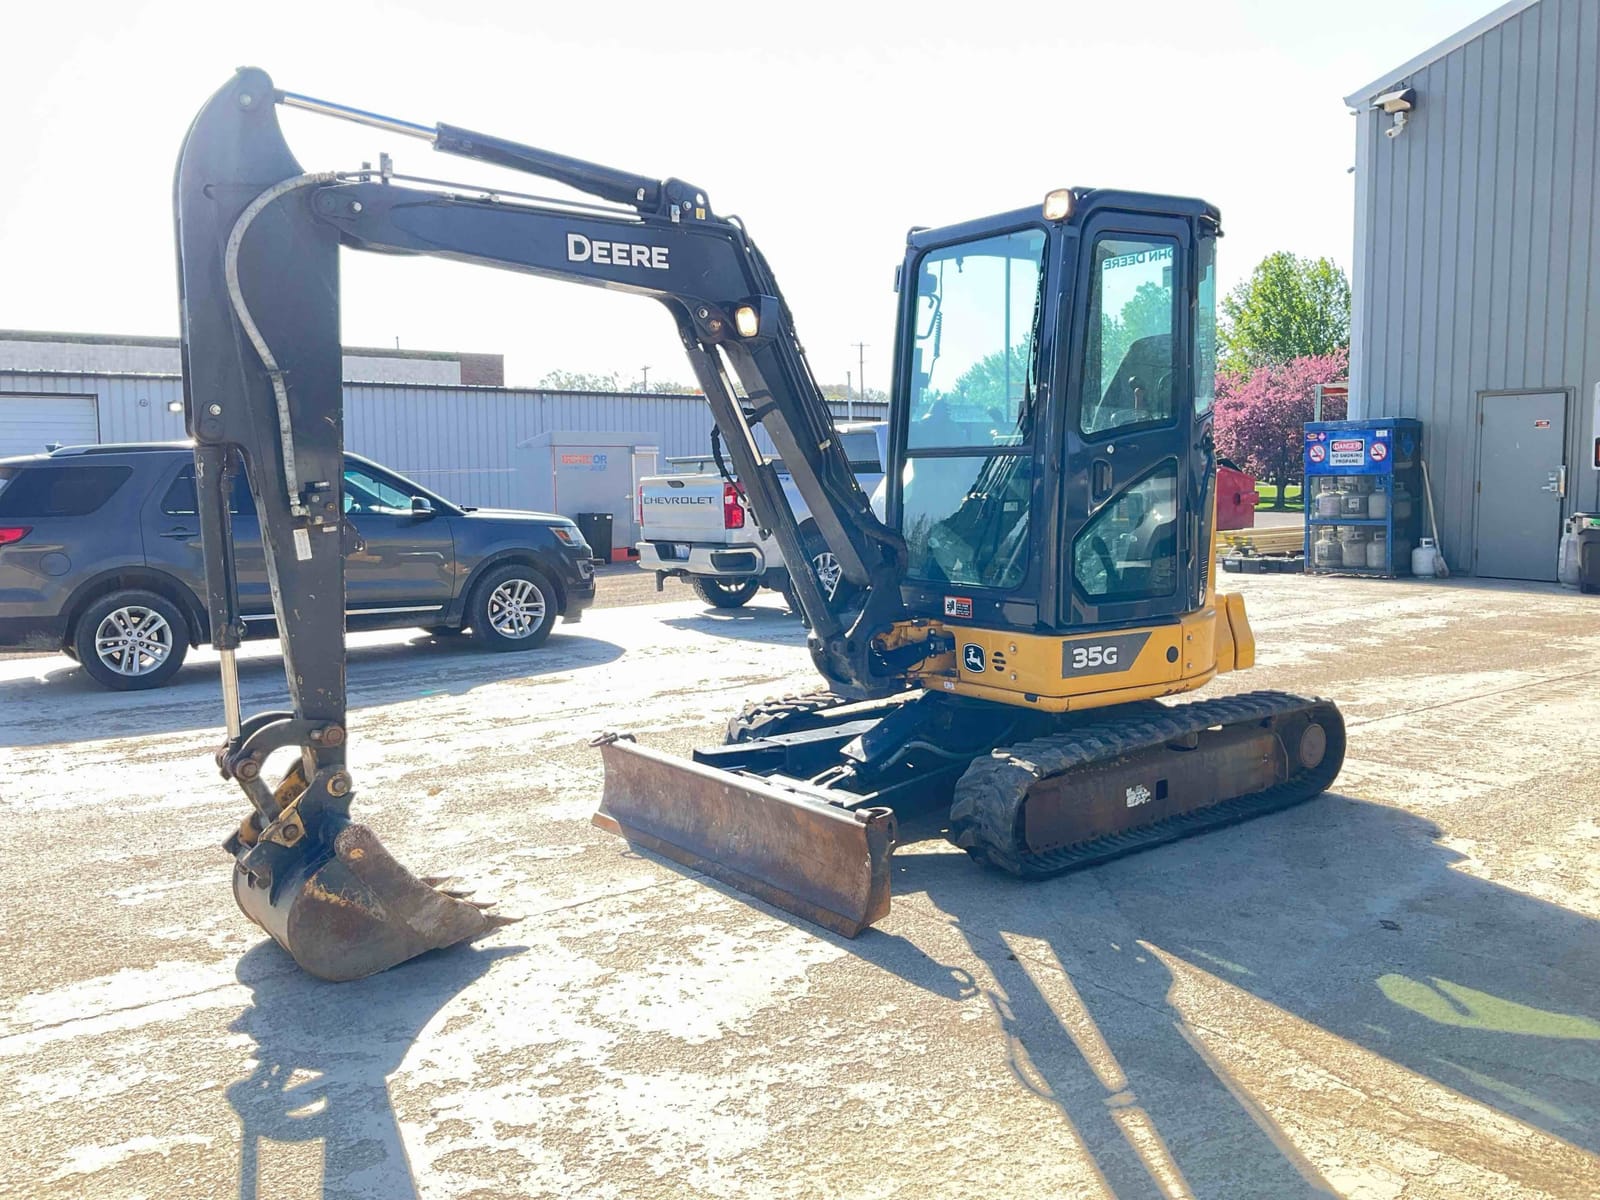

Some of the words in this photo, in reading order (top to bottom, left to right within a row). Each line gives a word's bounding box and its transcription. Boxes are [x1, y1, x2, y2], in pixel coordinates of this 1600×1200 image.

[567, 233, 670, 270] DEERE
[643, 496, 715, 505] CHEVROLET
[1072, 646, 1118, 669] 35G
